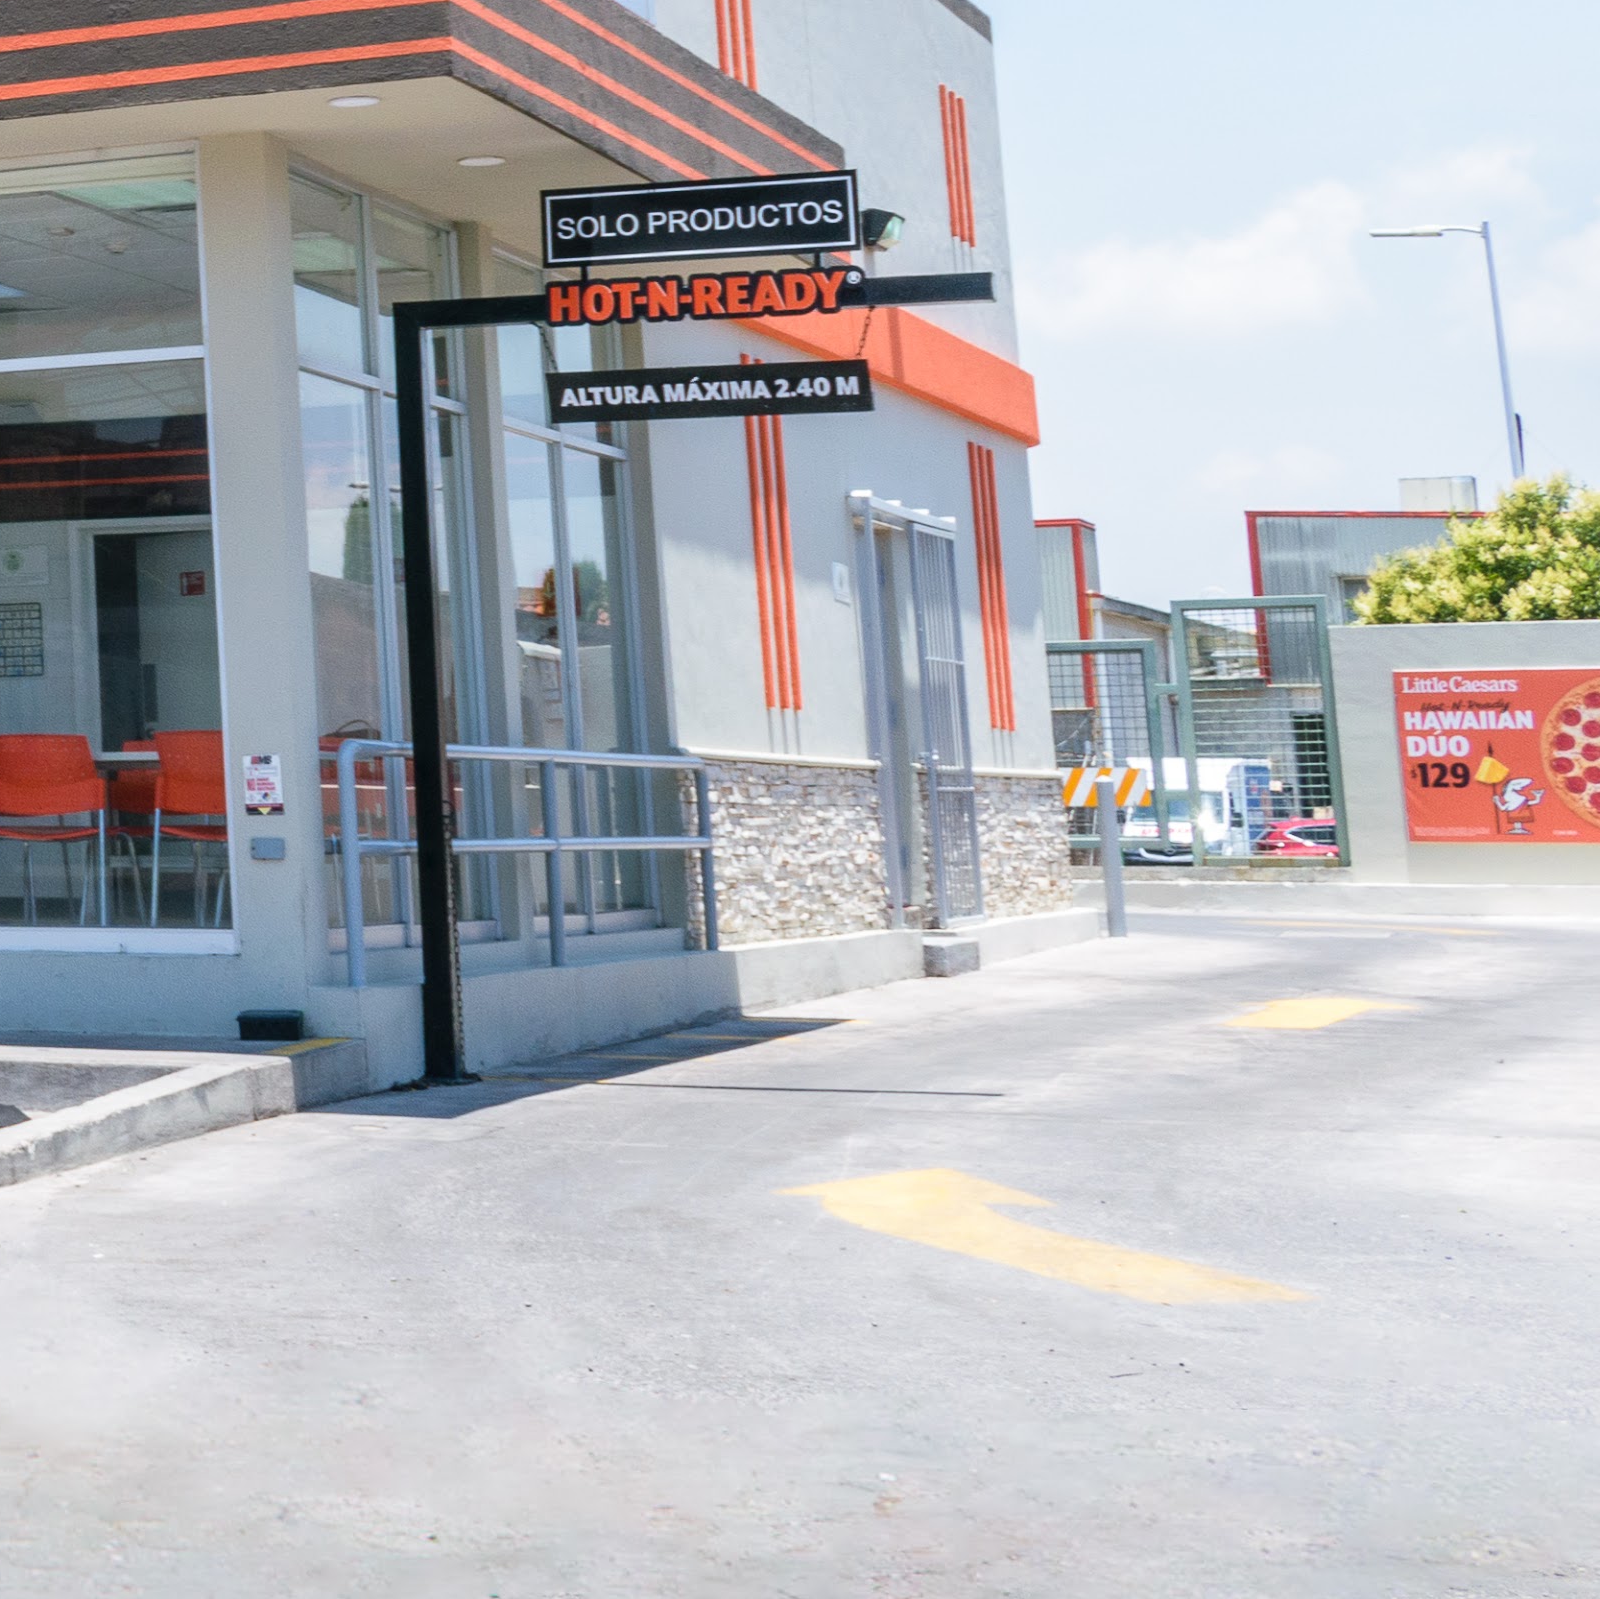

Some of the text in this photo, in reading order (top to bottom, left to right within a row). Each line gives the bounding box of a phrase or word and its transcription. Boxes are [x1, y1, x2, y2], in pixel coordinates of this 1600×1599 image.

[557, 199, 844, 240] SOLO PRODUCTOS
[548, 270, 847, 323] HOT-N-READY
[560, 375, 860, 408] ALTURA MÁXIMA 2.40 M
[1401, 676, 1518, 694] Little Caesars
[1403, 710, 1534, 730] HAWAIIAN
[1405, 730, 1470, 758] DÚO
[1410, 762, 1470, 788] $129
